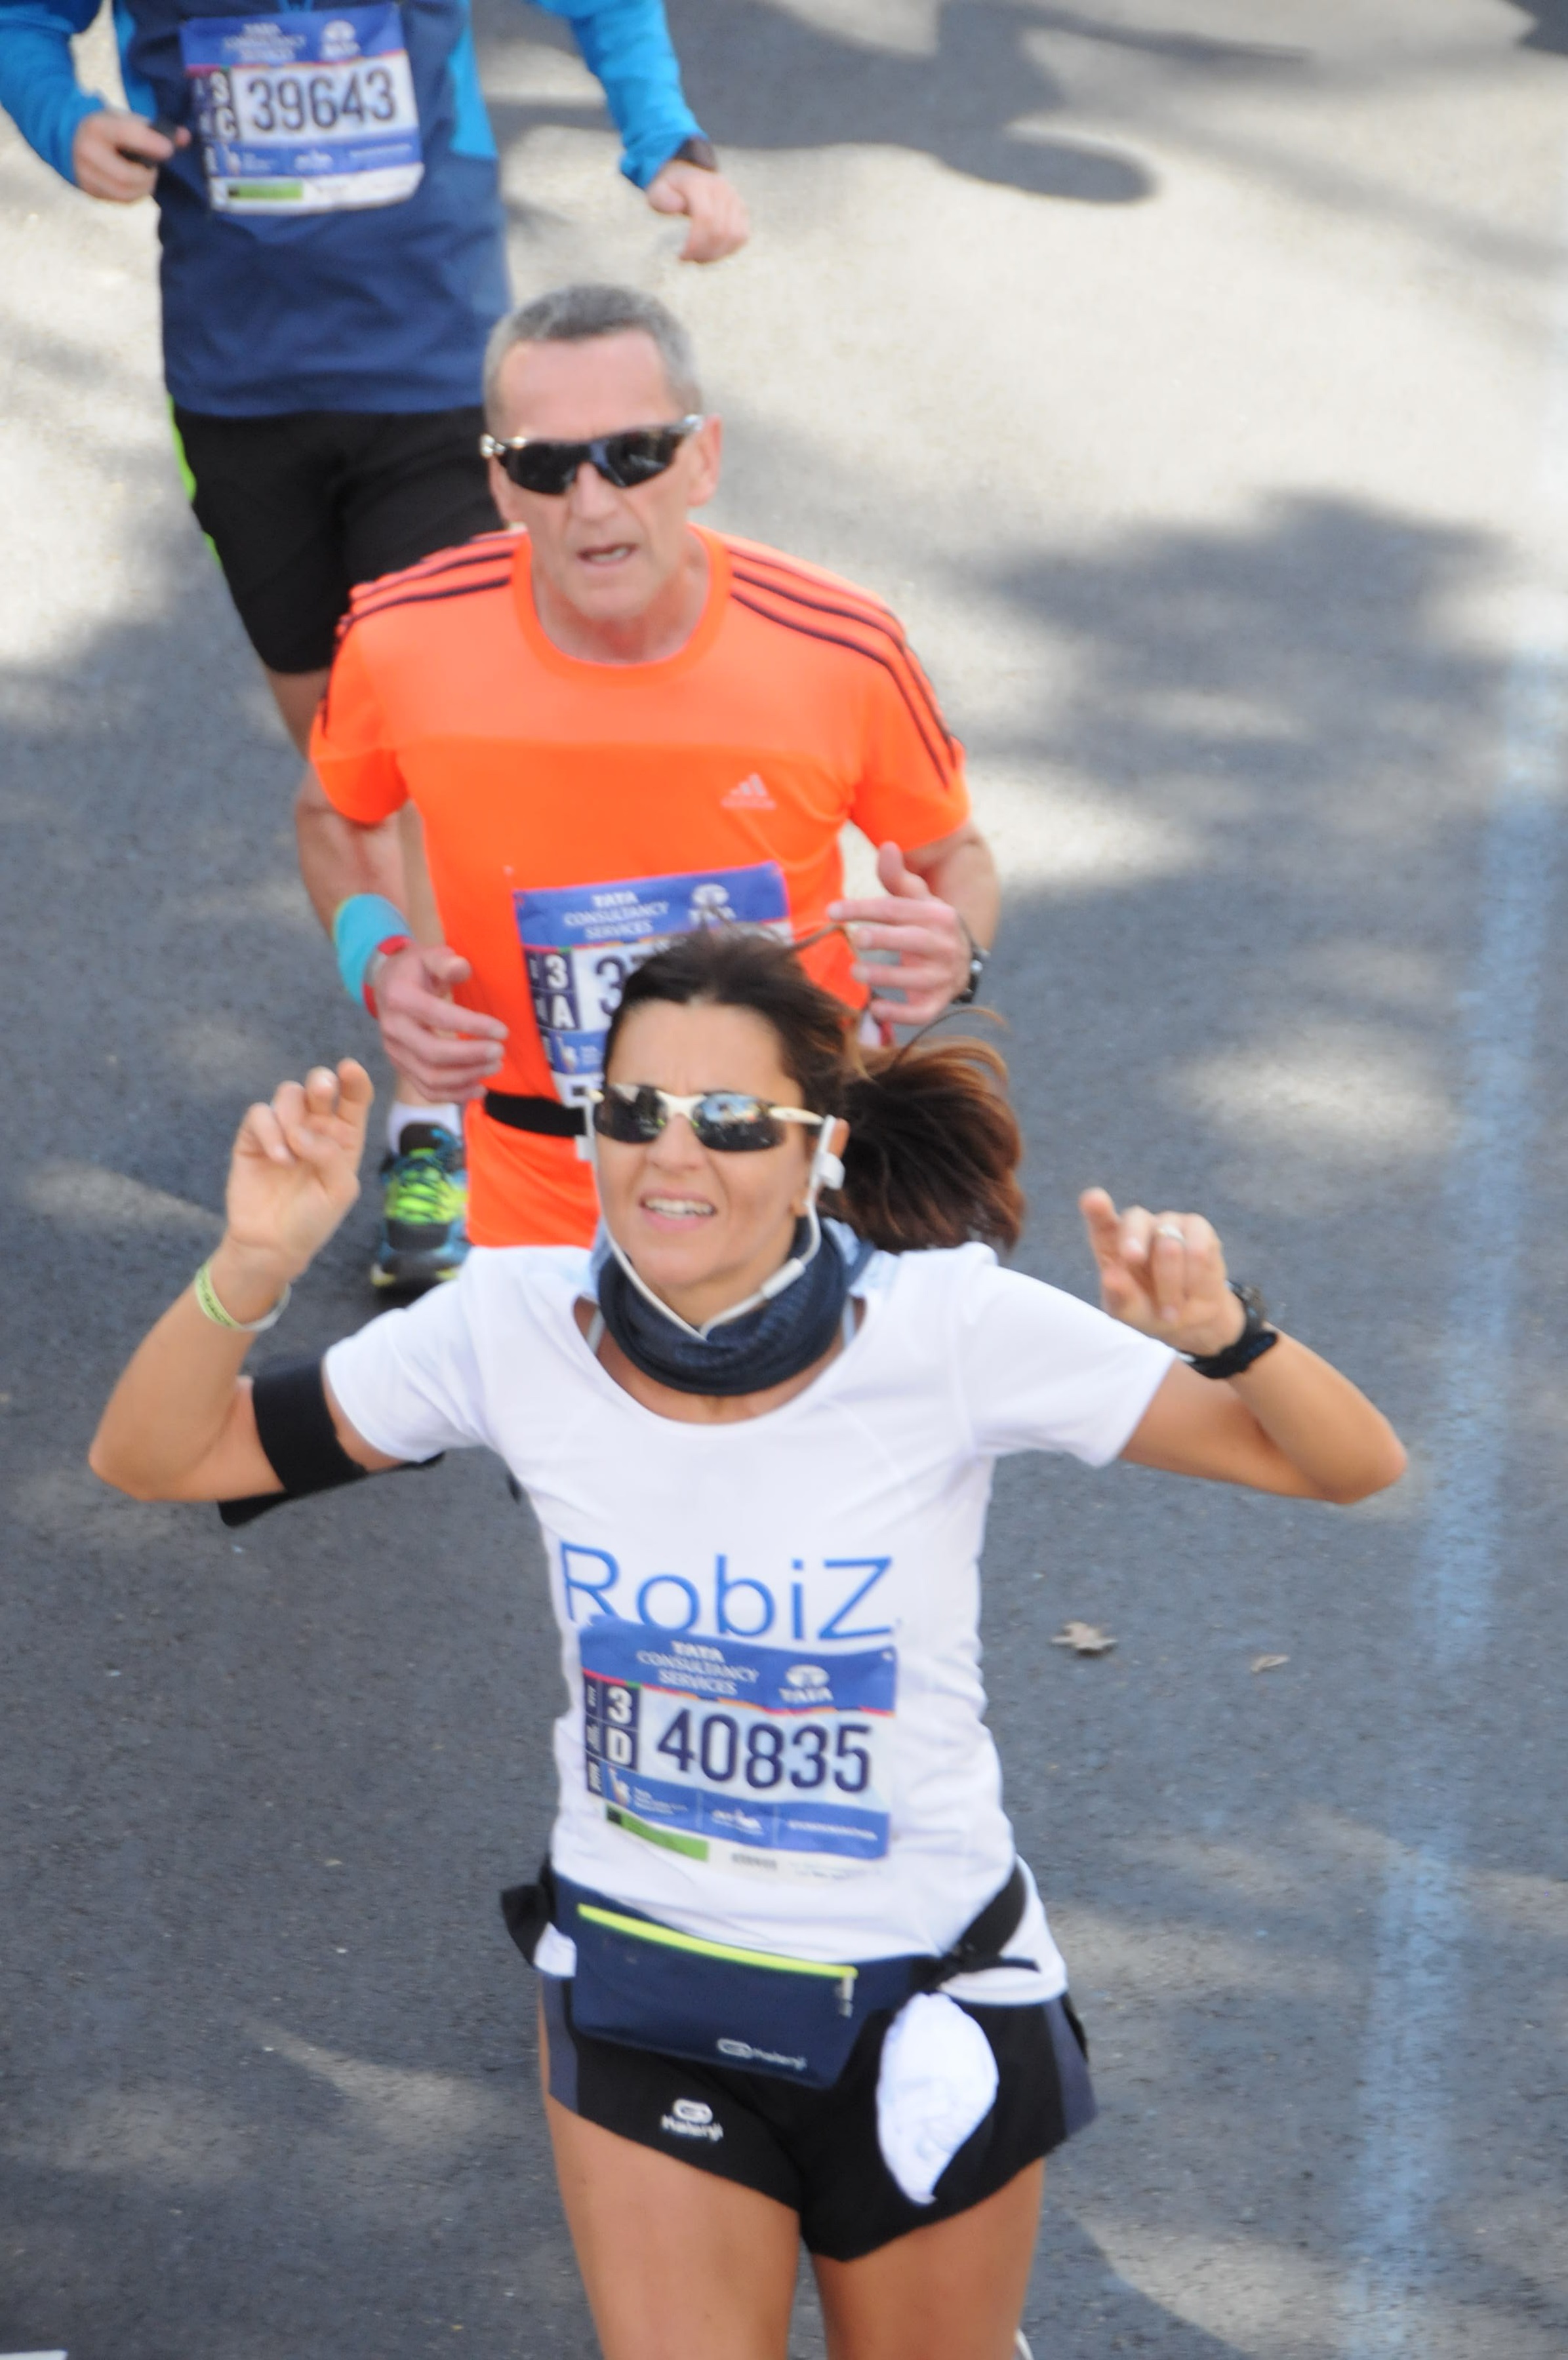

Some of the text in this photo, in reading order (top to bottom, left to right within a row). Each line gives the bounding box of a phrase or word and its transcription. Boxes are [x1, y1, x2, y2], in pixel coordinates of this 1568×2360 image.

[249, 68, 395, 131] 39643
[563, 901, 670, 927] CONSULTANCY
[592, 890, 640, 909] TATA
[584, 919, 654, 940] SERVICES
[545, 954, 569, 989] 3
[552, 993, 576, 1029] A
[560, 1540, 894, 1640] RobiZ
[636, 1650, 759, 1684] CONSULTANCY
[672, 1641, 725, 1663] TATA
[658, 1668, 738, 1696] SERVICES
[778, 1687, 834, 1704] TATA
[607, 1685, 632, 1725] 3
[606, 1726, 633, 1766] D
[656, 1708, 872, 1794] 40835
